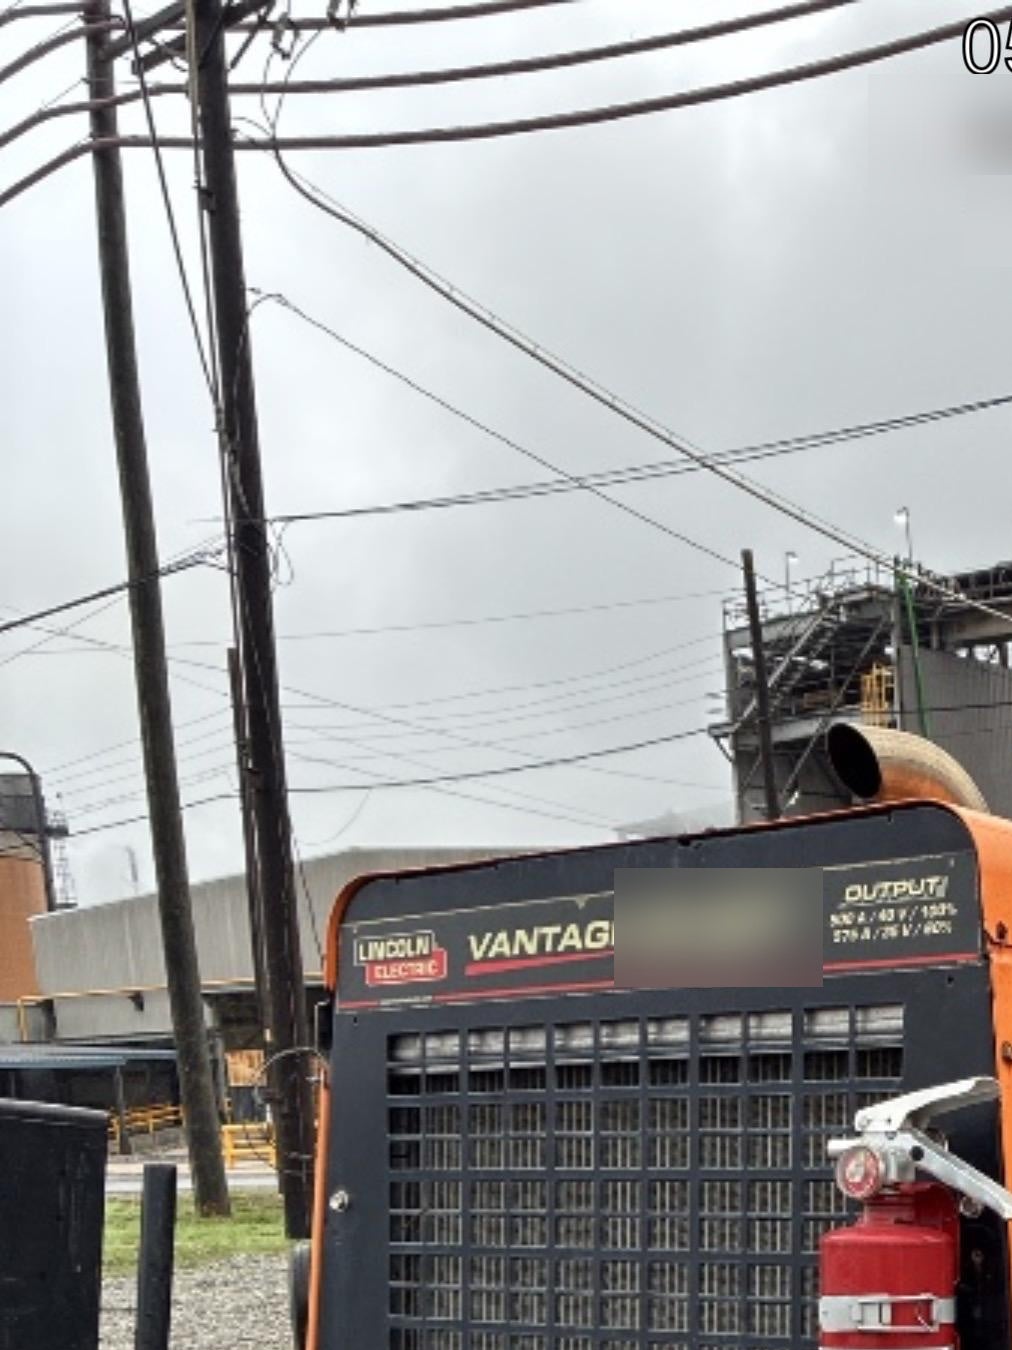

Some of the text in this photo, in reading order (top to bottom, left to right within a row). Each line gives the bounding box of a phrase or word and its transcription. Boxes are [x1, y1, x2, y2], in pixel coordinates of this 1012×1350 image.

[844, 876, 943, 902] OUTPUT
[358, 935, 430, 961] LINCOLN
[469, 920, 614, 960] VANTAG
[374, 961, 439, 979] ELECTRIC
